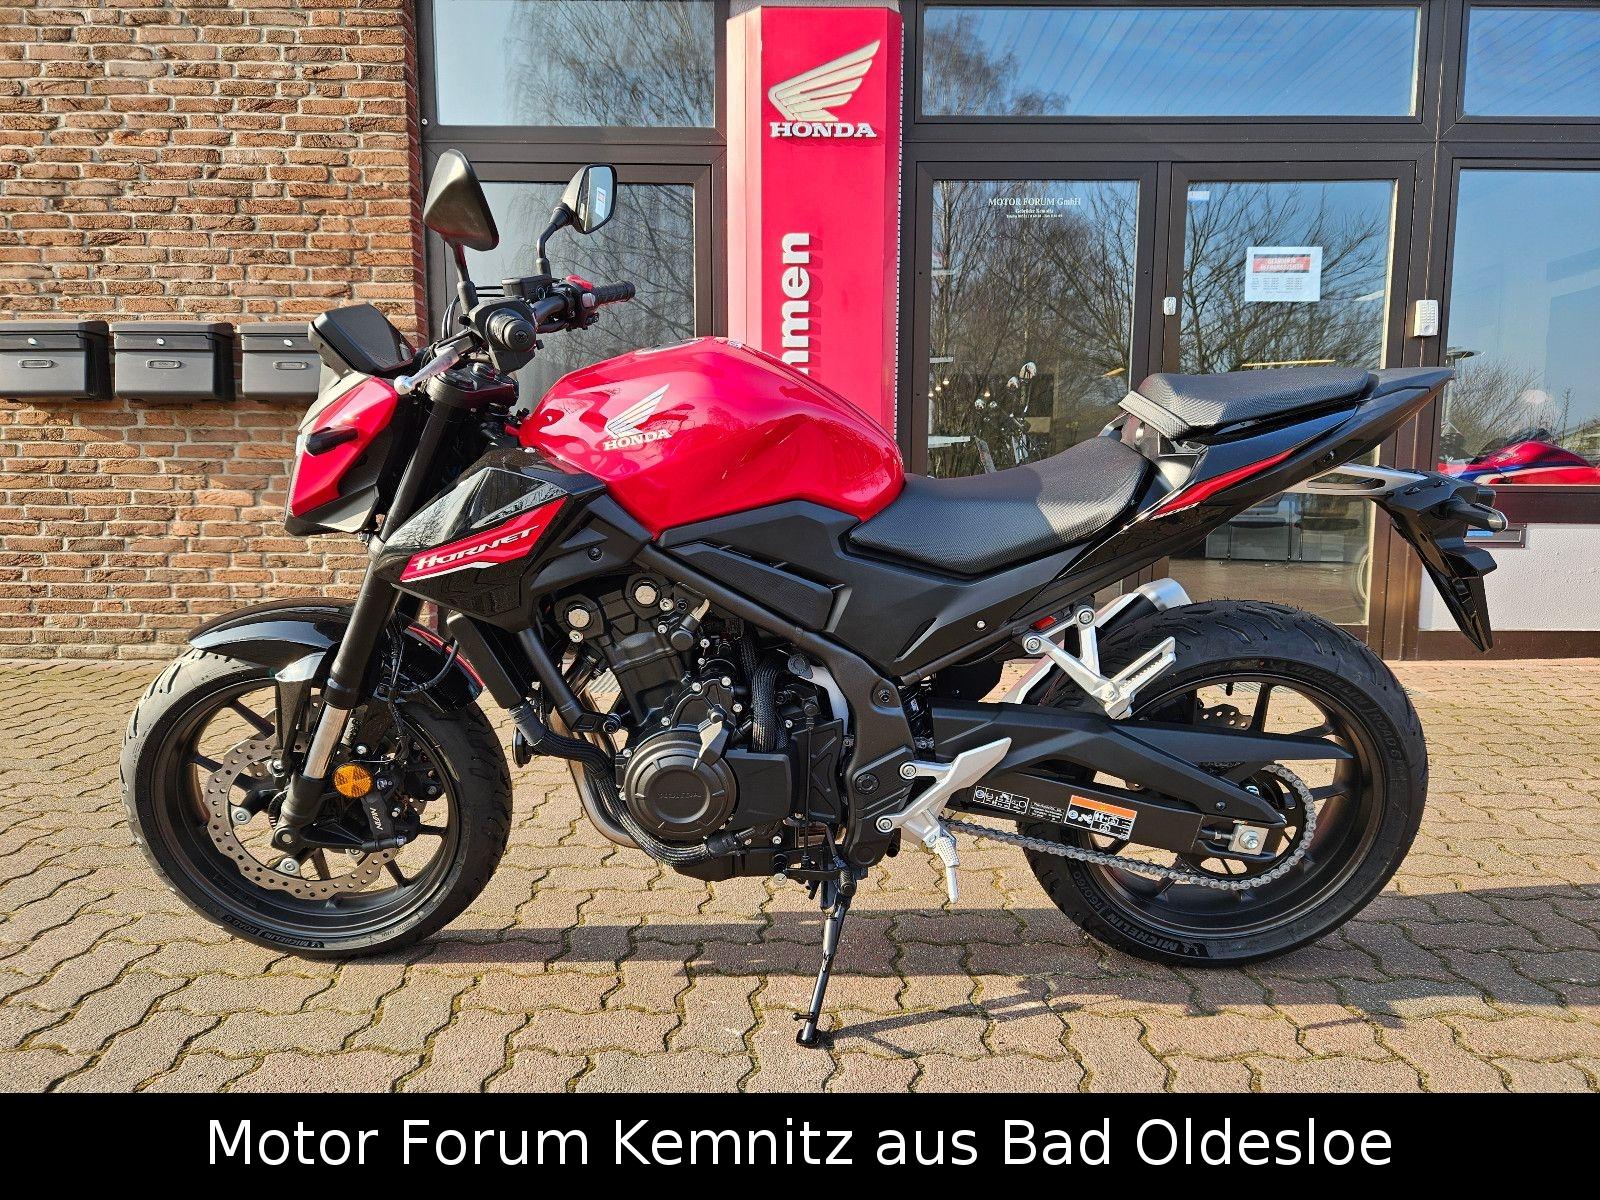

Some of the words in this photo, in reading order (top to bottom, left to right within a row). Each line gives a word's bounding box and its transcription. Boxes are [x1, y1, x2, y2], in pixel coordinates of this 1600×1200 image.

[770, 121, 877, 138] HONDA
[988, 197, 1021, 206] MOTOR
[1023, 197, 1055, 206] FORUM
[1057, 196, 1081, 206] GmbH
[602, 429, 673, 451] HONDA
[412, 525, 540, 570] HORNET
[264, 931, 310, 948] MICHELIN
[1106, 912, 1180, 951] MICHELIN
